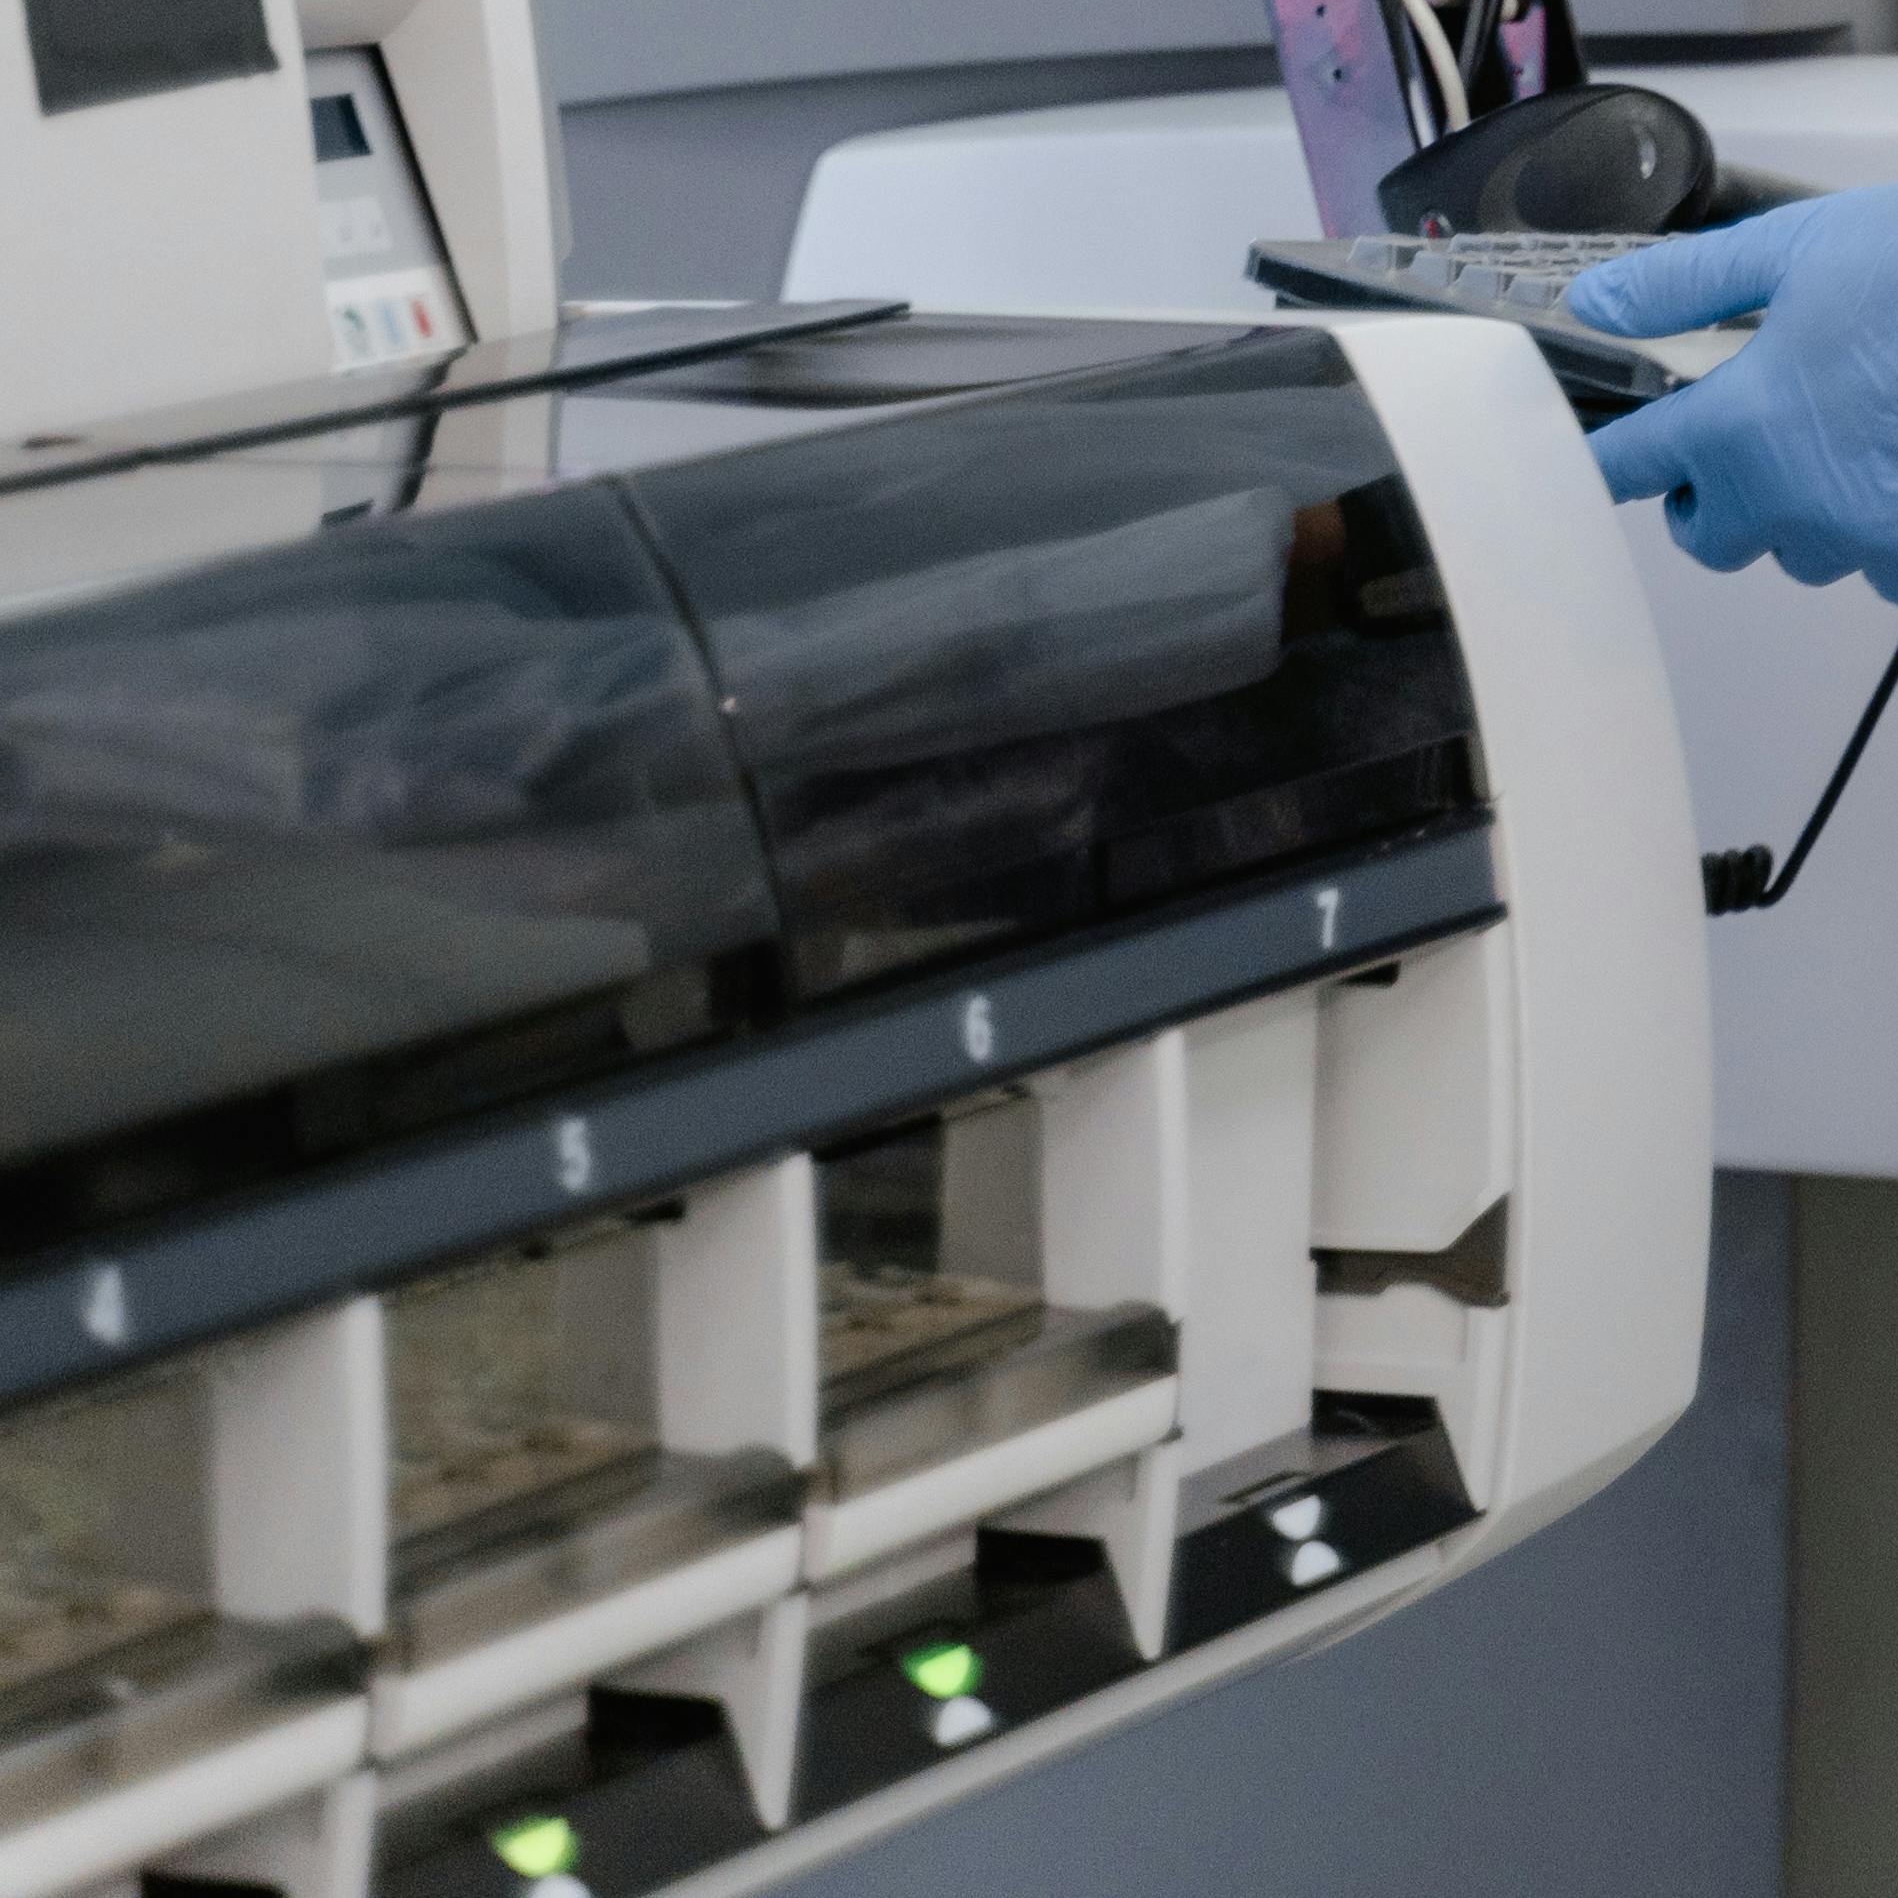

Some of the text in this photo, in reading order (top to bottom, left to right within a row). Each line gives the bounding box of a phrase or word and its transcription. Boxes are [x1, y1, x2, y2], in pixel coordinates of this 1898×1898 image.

[1314, 886, 1342, 950] 7
[960, 994, 995, 1063] 6
[554, 1116, 595, 1195] 5
